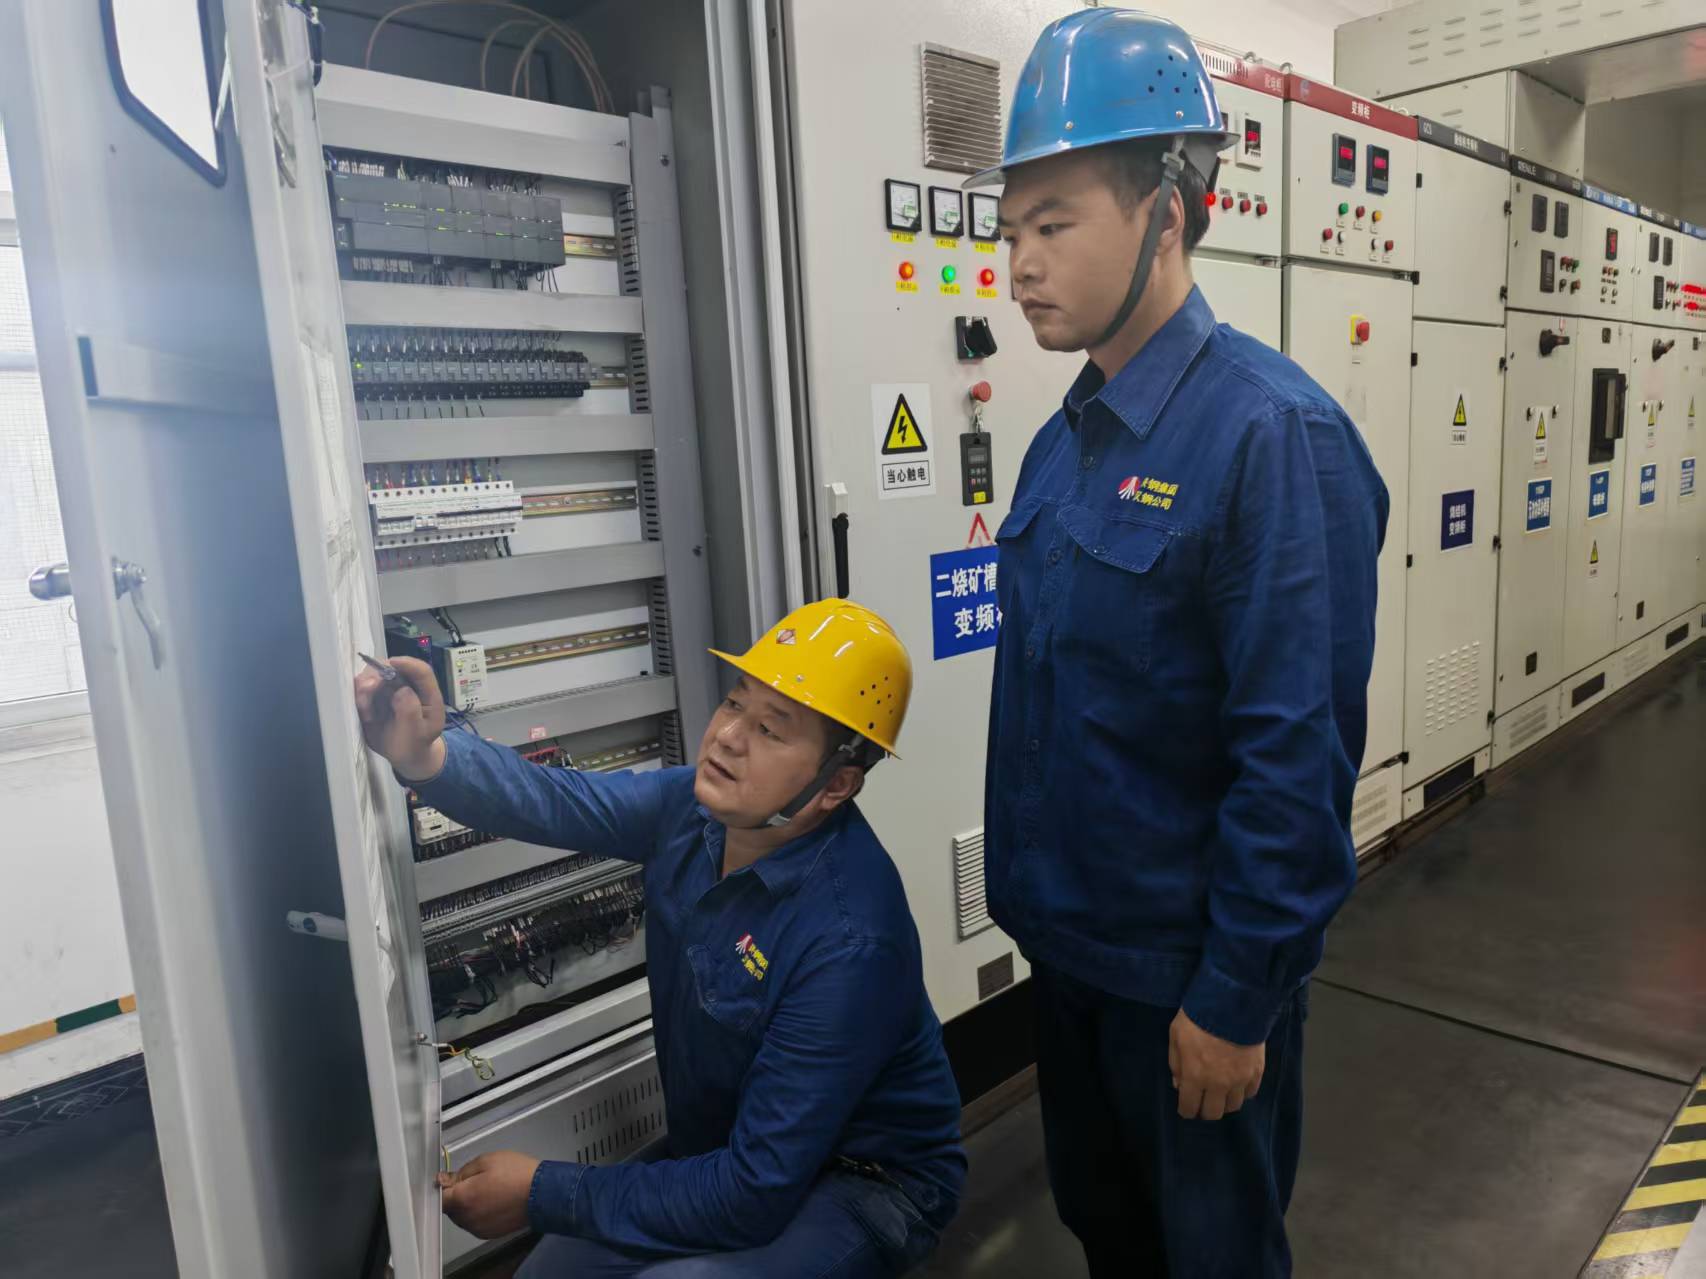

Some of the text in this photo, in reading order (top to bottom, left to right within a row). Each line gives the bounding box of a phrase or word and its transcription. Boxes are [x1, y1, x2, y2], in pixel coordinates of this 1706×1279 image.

[1351, 101, 1371, 119] 变频柜
[886, 466, 927, 484] 当心触电
[1449, 520, 1466, 536] 变频柜
[935, 562, 998, 599] 二烧矿槽
